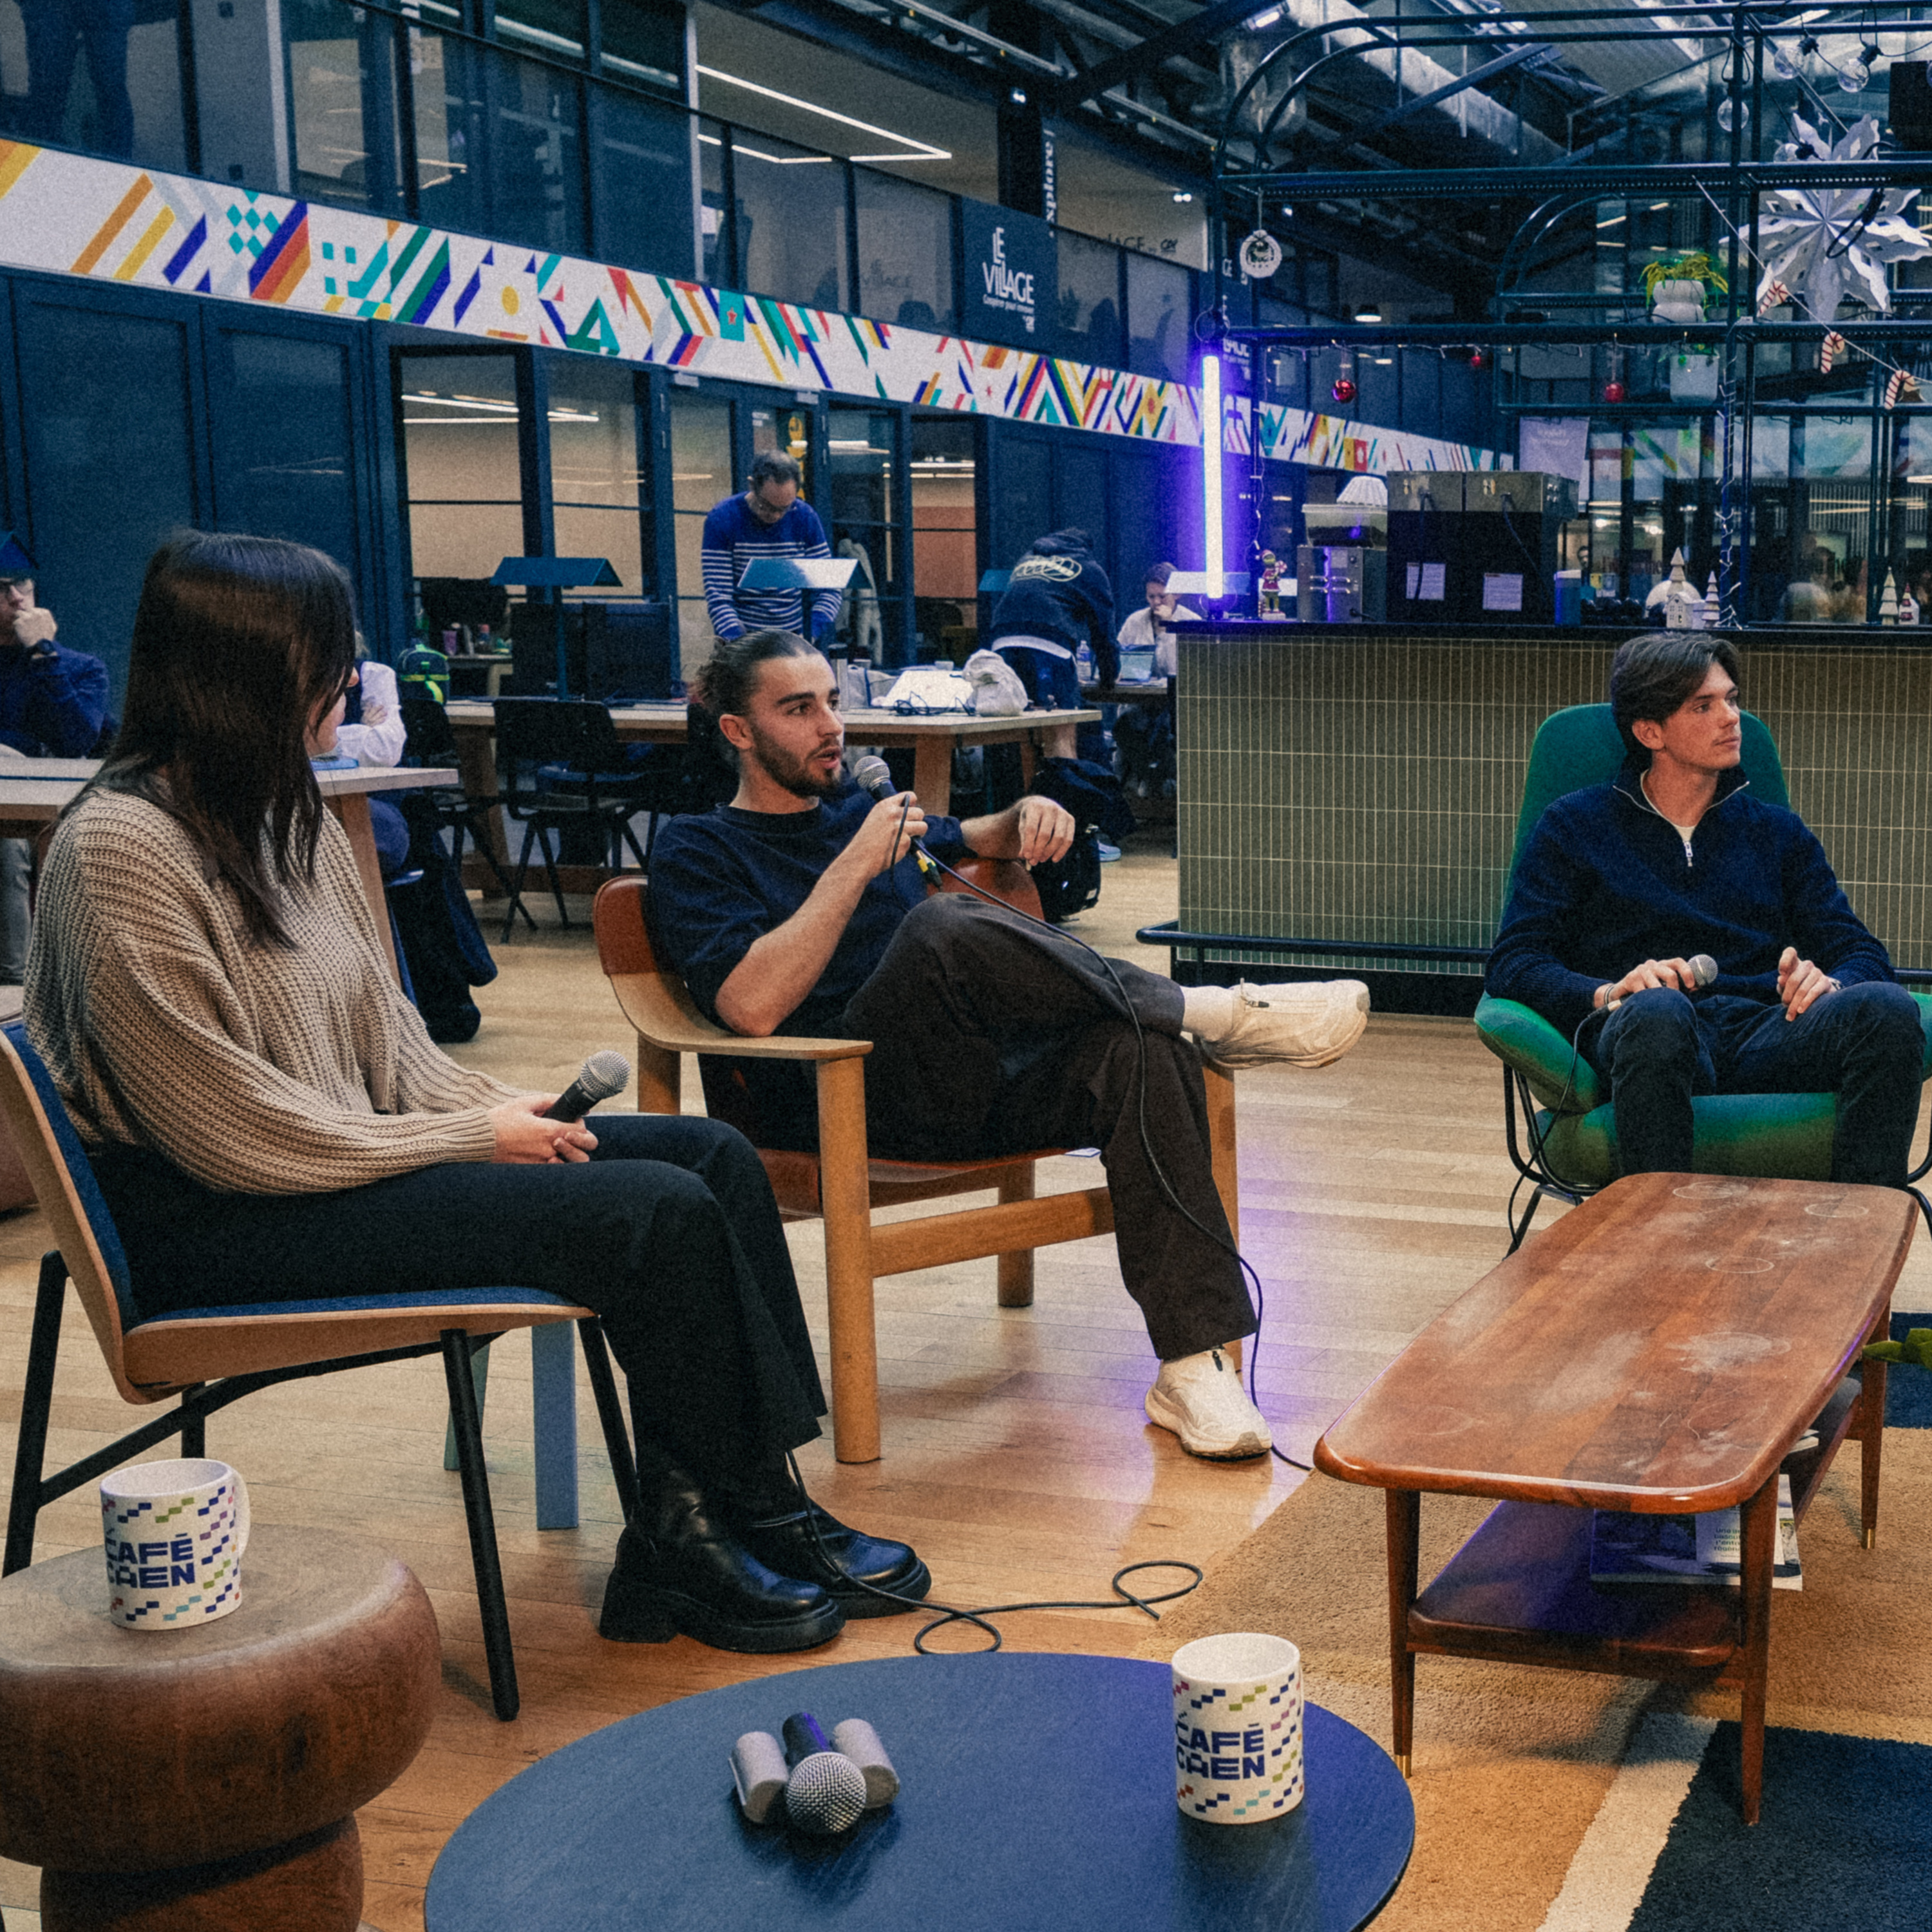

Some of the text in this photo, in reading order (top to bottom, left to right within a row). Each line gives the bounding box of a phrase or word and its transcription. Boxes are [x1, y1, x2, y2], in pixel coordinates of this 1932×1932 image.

[992, 227, 1006, 264] LE
[982, 260, 1035, 305] VILLAGE
[107, 1559, 196, 1589] CAEN
[1176, 1744, 1265, 1781] CAEN
